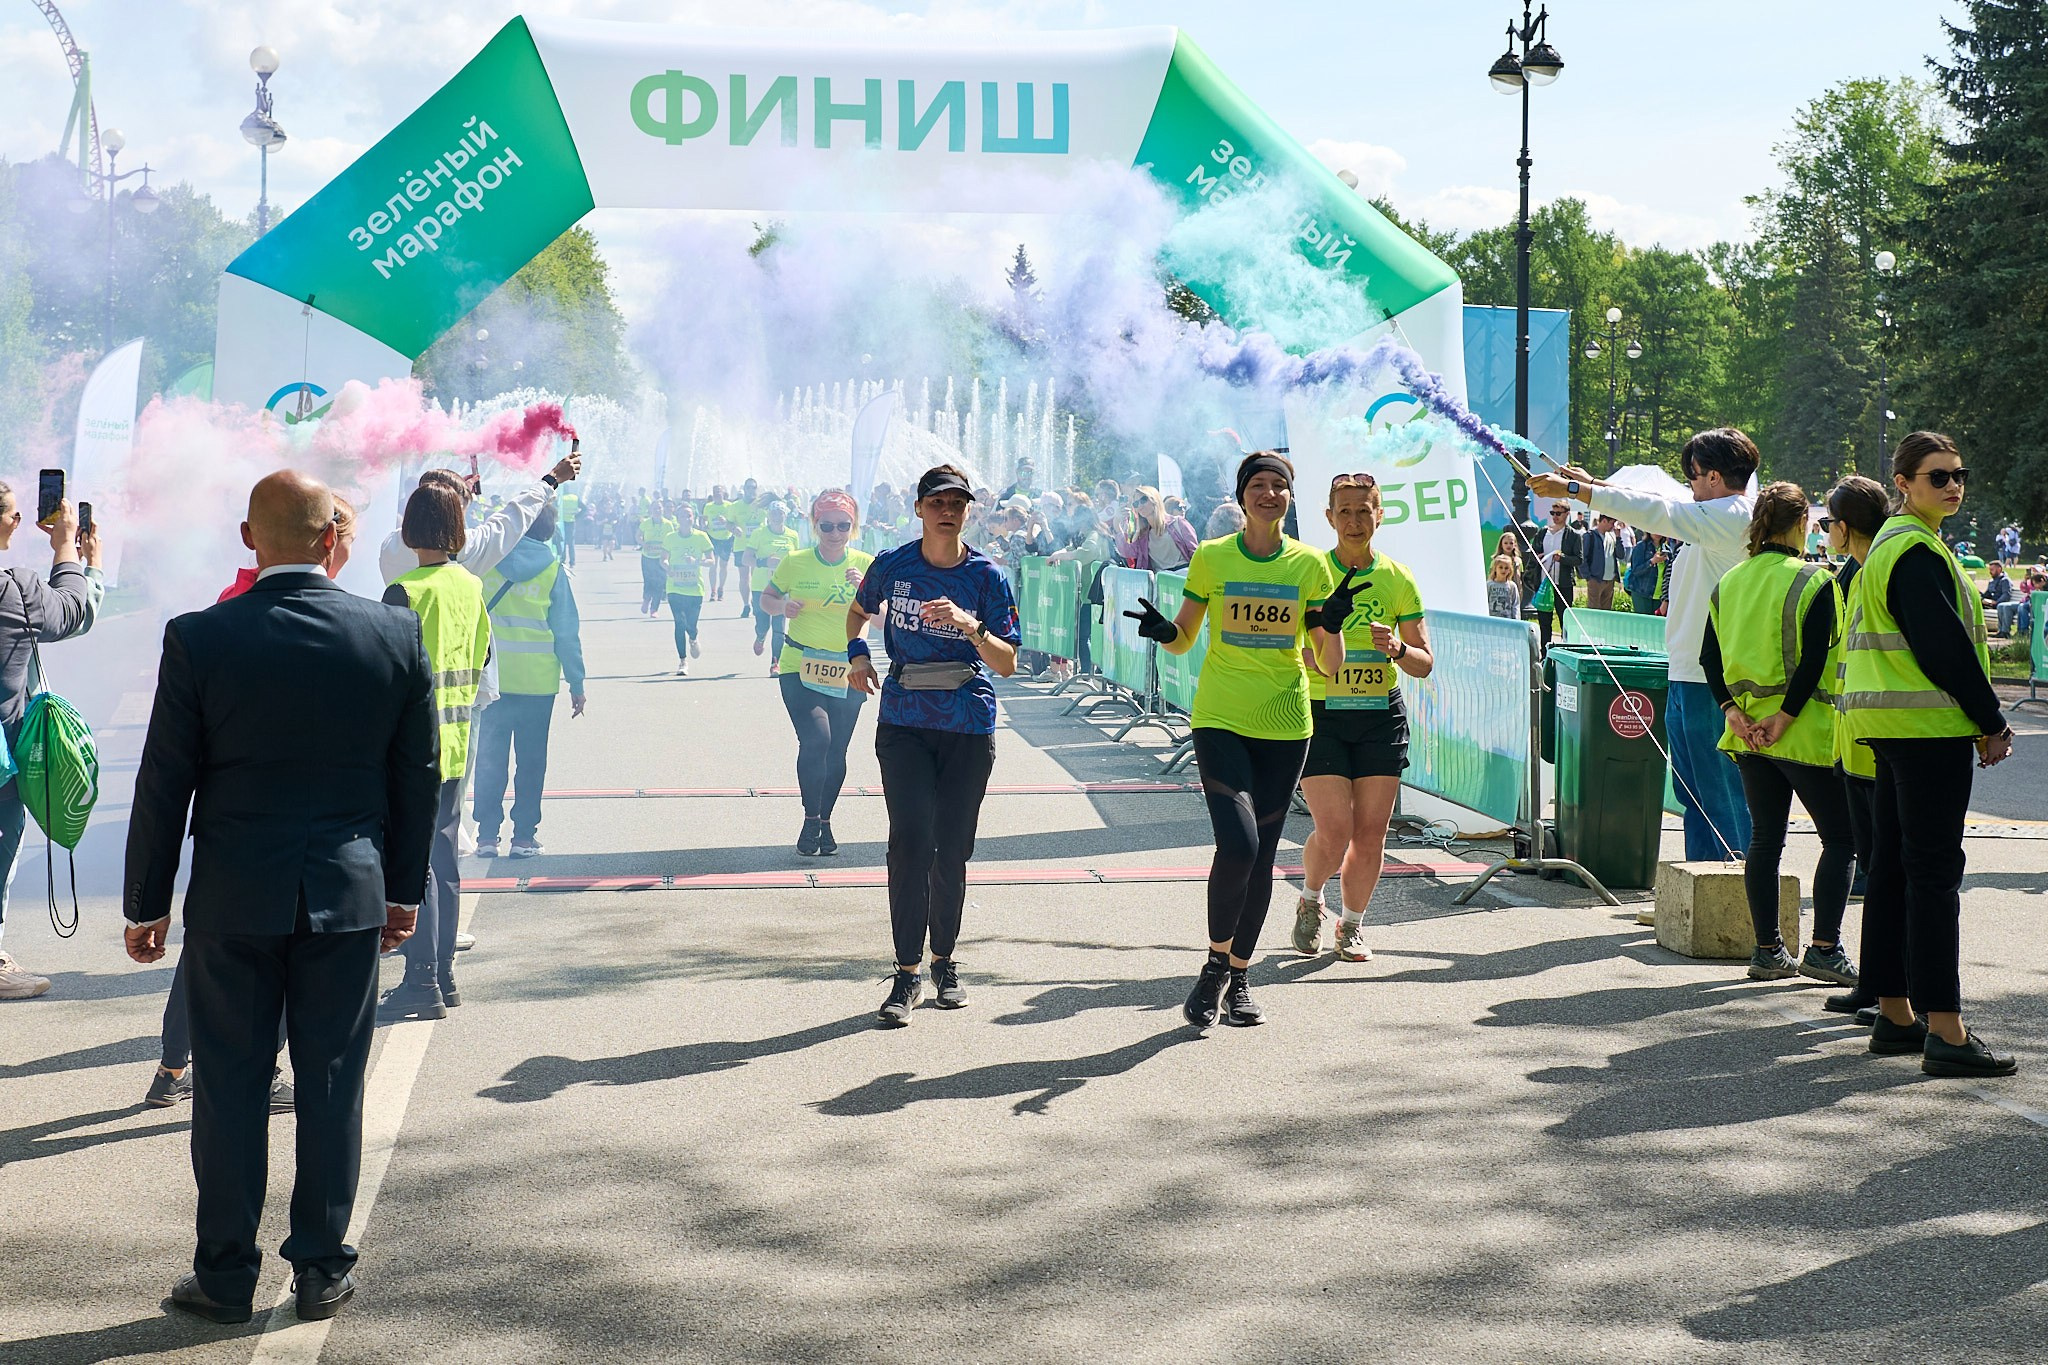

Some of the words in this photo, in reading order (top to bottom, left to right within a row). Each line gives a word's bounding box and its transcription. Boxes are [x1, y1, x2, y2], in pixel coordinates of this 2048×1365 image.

[630, 69, 1069, 154] ФИНИШ
[348, 115, 499, 250] зелёный
[371, 146, 524, 280] марафон
[1380, 478, 1468, 525] БЕР
[894, 580, 912, 589] ВЭБ
[890, 609, 920, 632] 70.3
[1230, 603, 1291, 623] 11686
[805, 662, 847, 679] 11507
